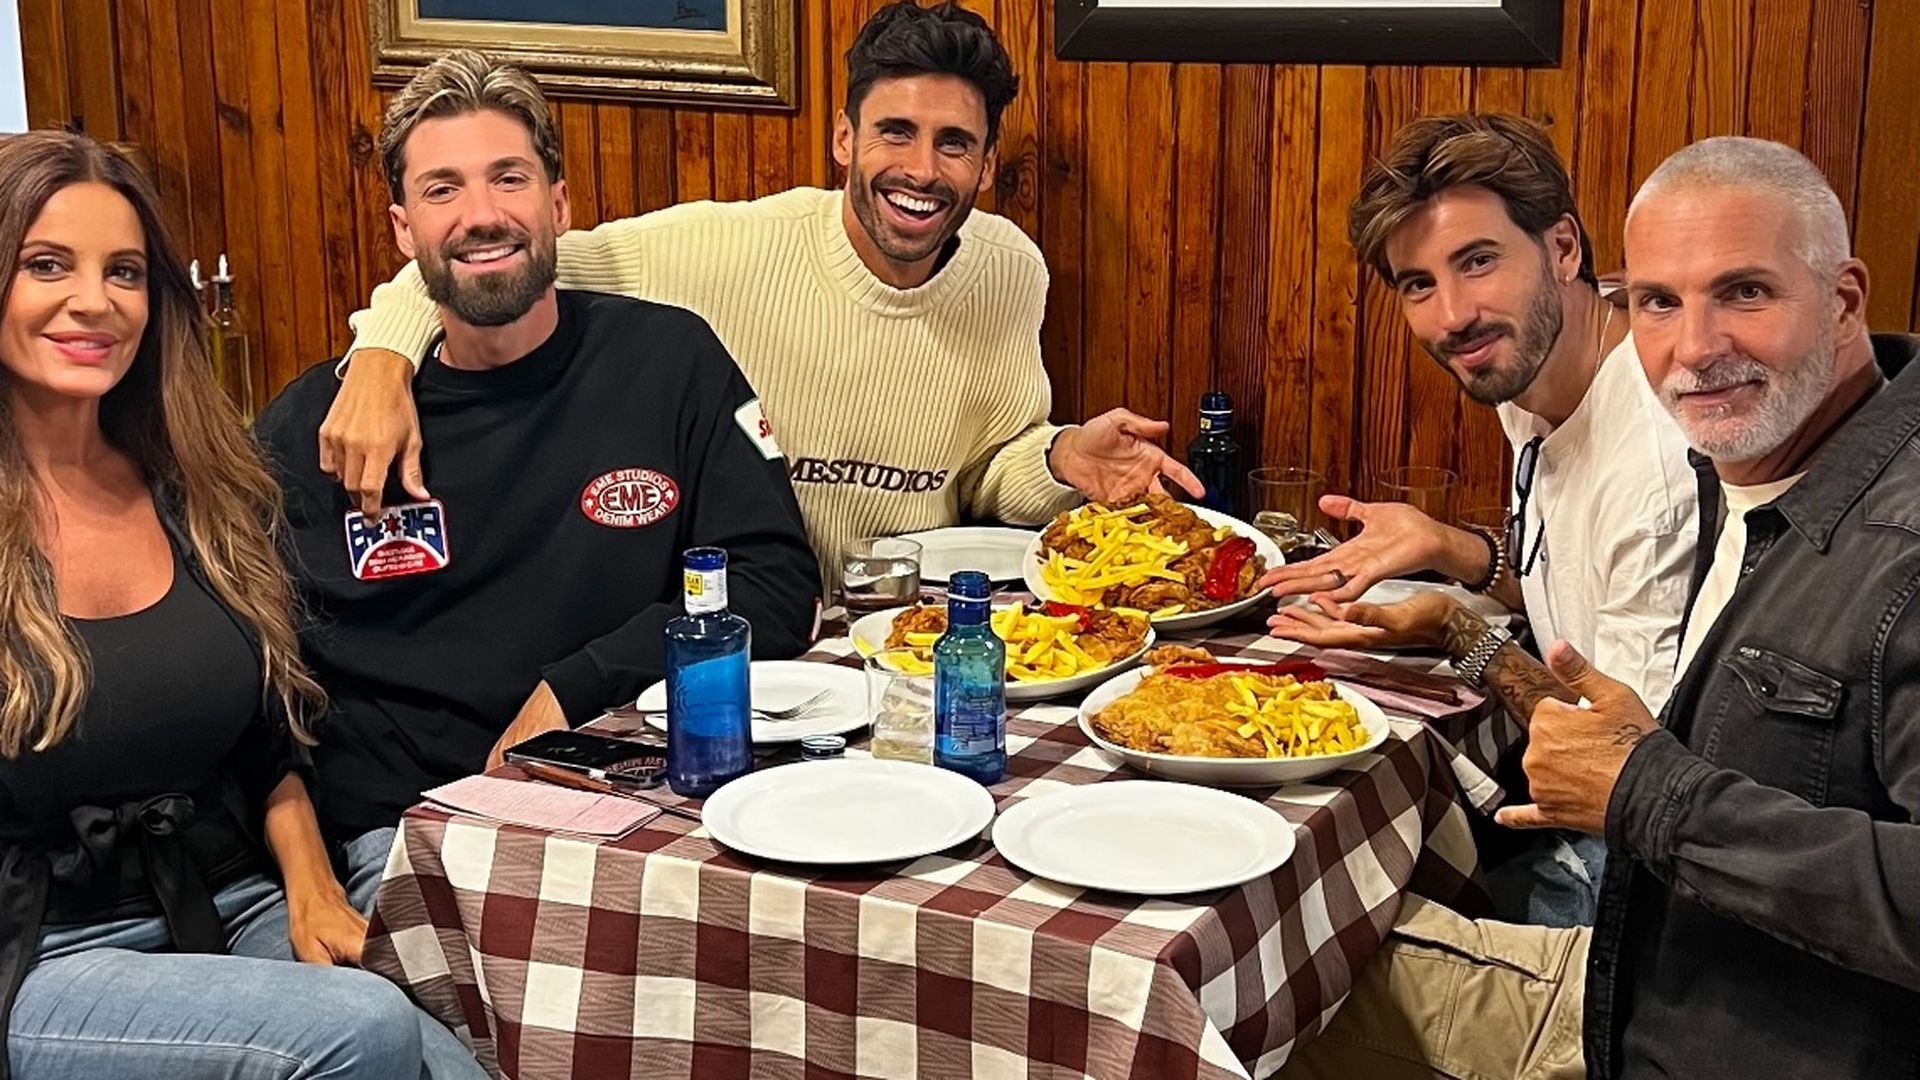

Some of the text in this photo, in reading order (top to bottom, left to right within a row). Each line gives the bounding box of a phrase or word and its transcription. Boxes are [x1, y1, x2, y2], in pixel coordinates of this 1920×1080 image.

[591, 469, 670, 496] EME STUDIOS
[602, 483, 661, 512] EME
[594, 501, 669, 526] DENIM WEAR
